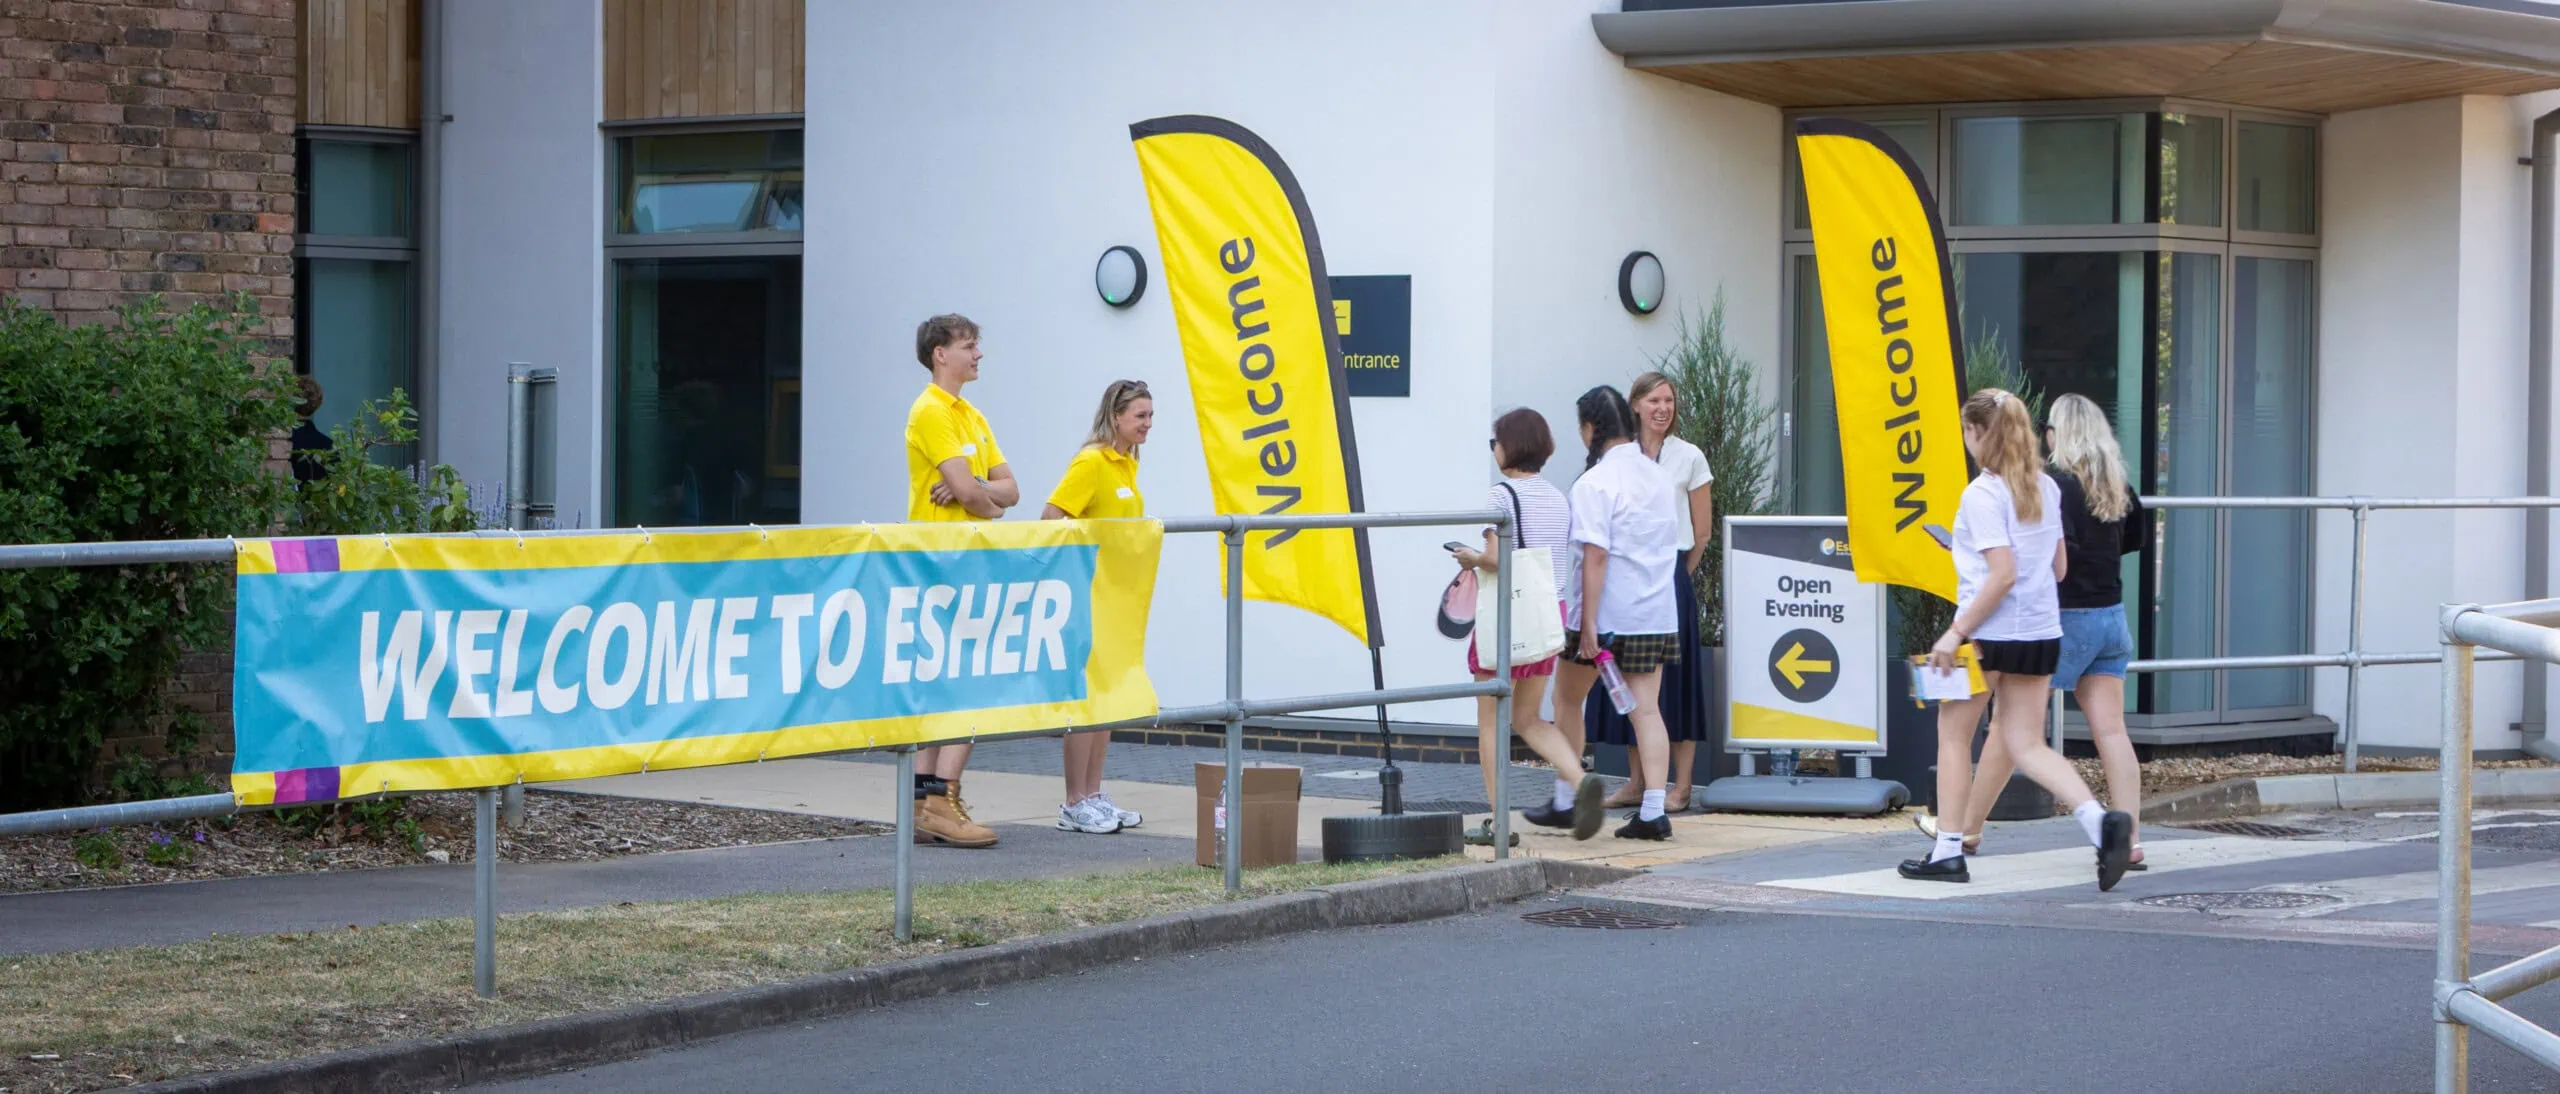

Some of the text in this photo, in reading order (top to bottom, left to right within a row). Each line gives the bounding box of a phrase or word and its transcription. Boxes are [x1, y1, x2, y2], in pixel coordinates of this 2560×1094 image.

[1219, 236, 1302, 551] Welcome
[1342, 352, 1400, 369] ntrance
[1871, 236, 1928, 534] Welcome
[1765, 599, 1844, 623] Evening
[1777, 575, 1832, 598] Open
[359, 579, 1072, 723] WELCOME TO ESHER
